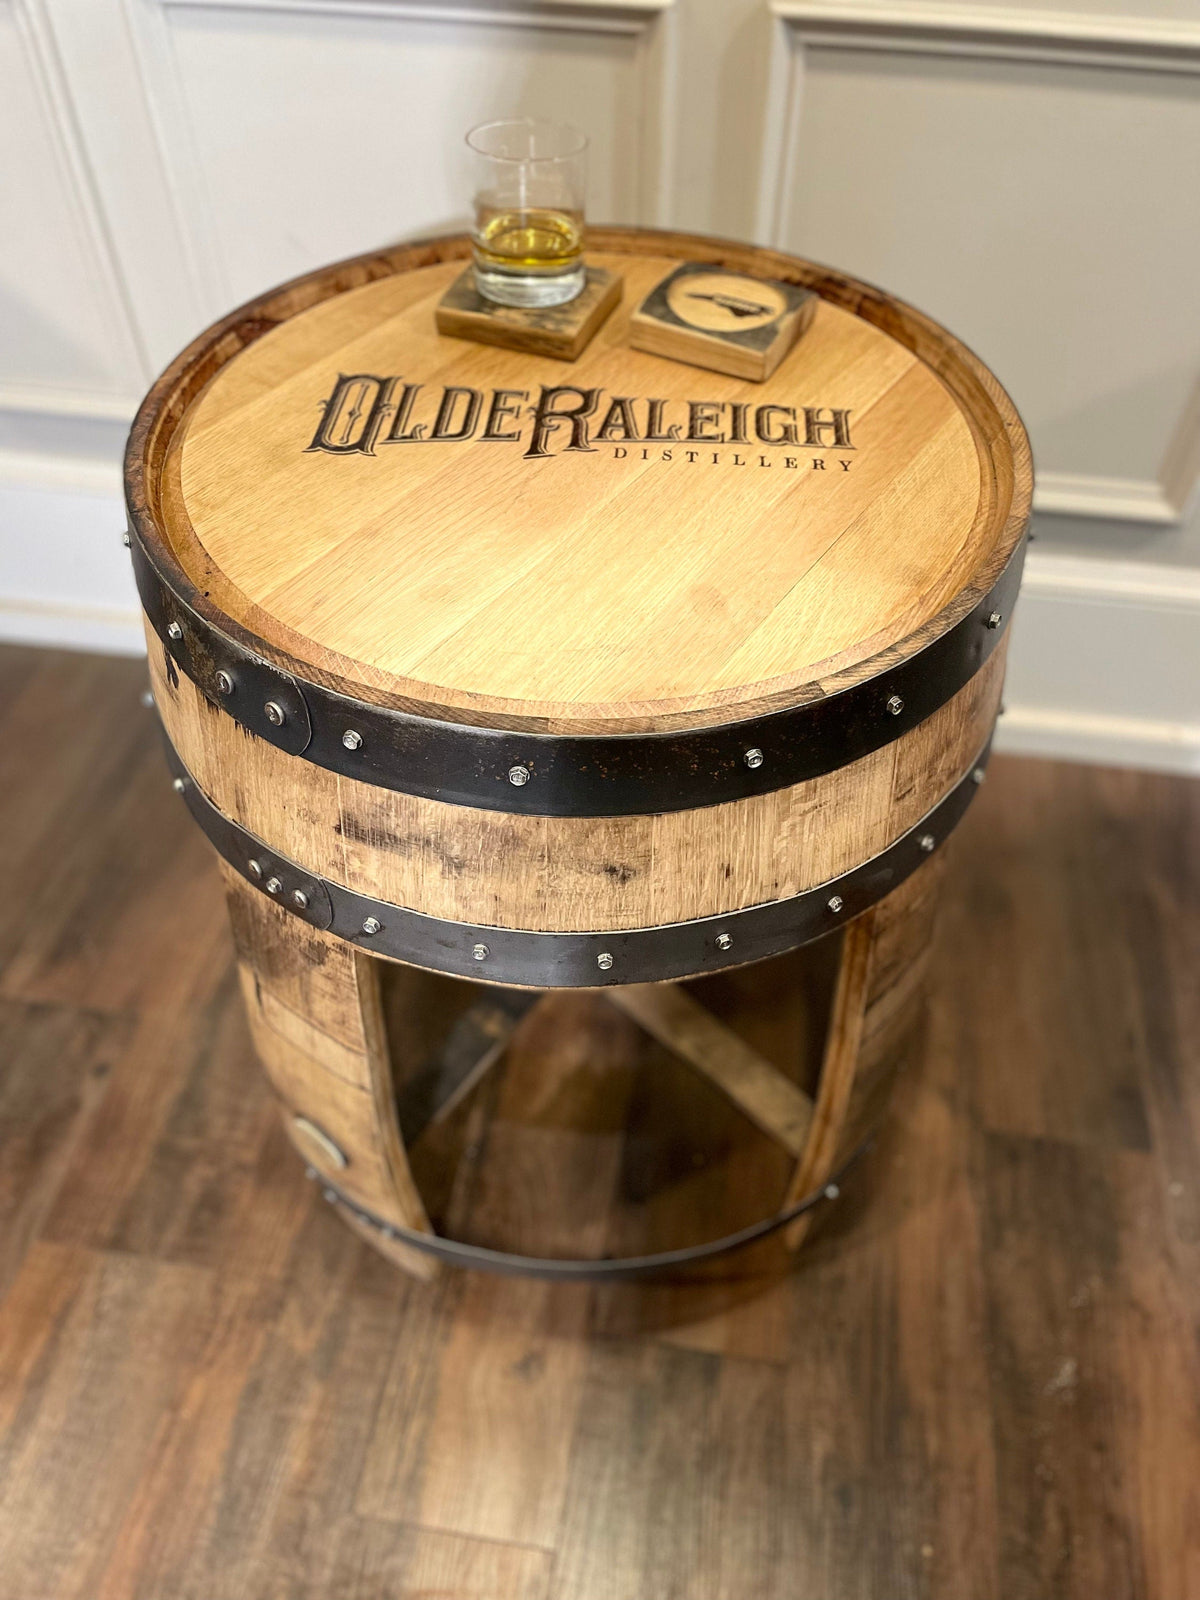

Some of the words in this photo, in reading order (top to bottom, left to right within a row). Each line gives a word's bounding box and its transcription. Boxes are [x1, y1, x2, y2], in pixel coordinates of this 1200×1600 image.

[302, 372, 530, 457] OLDE
[523, 384, 857, 459] RALEIGH
[612, 447, 855, 473] DISTILLERY
